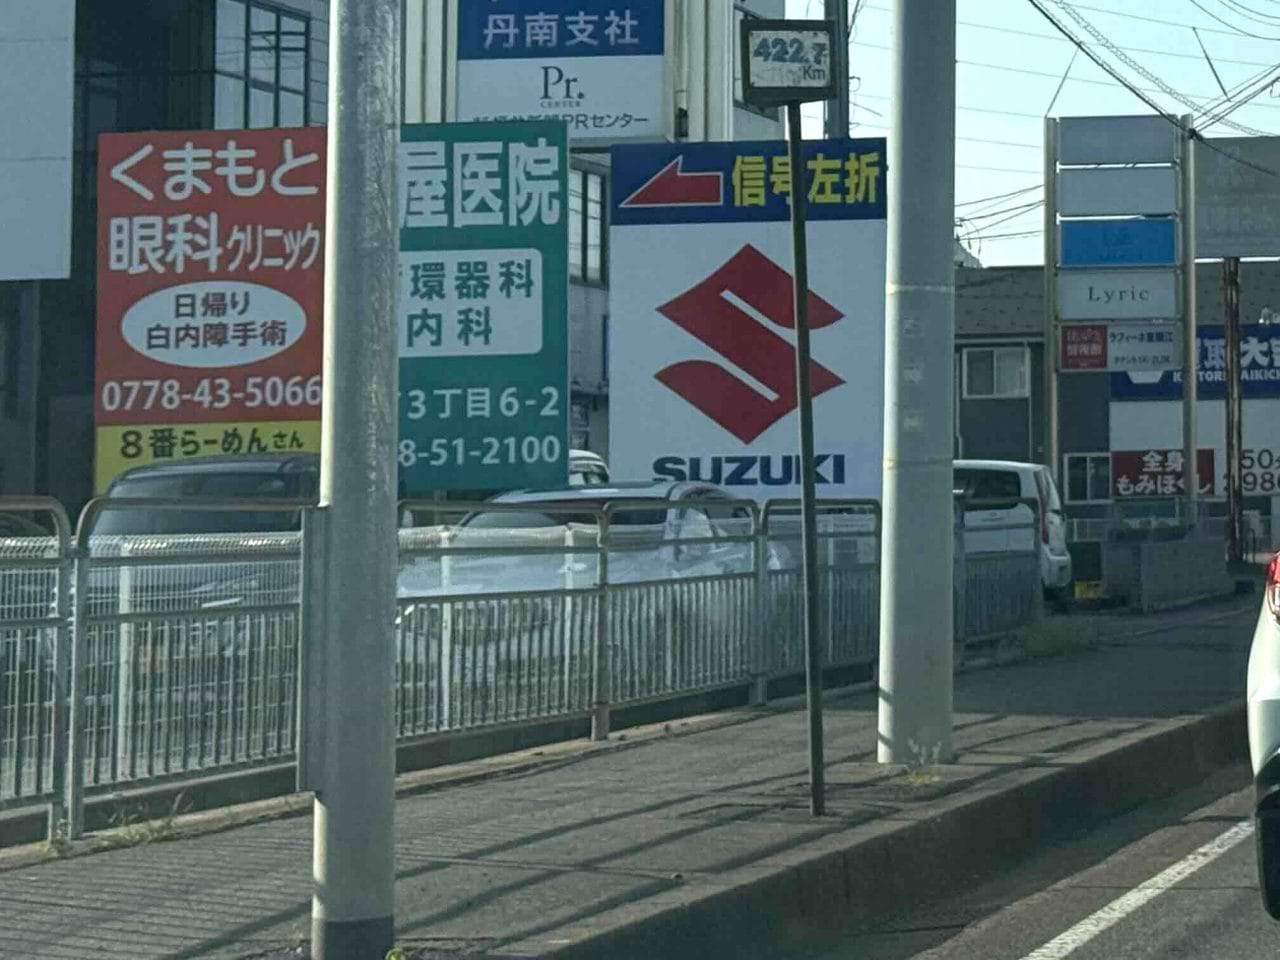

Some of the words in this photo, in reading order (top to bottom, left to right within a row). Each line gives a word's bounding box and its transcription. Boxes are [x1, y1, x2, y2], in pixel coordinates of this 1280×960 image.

[483, 9, 639, 49] 丹南支社
[110, 139, 319, 201] くまもと
[400, 259, 533, 300] 環器科
[1088, 286, 1149, 304] Lyric
[175, 291, 250, 319] 日帰り
[146, 320, 287, 350] 白内障手術
[102, 375, 321, 411] 0778-43-5066
[398, 386, 560, 419] 3丁目6-2
[653, 454, 845, 486] SUZUKI
